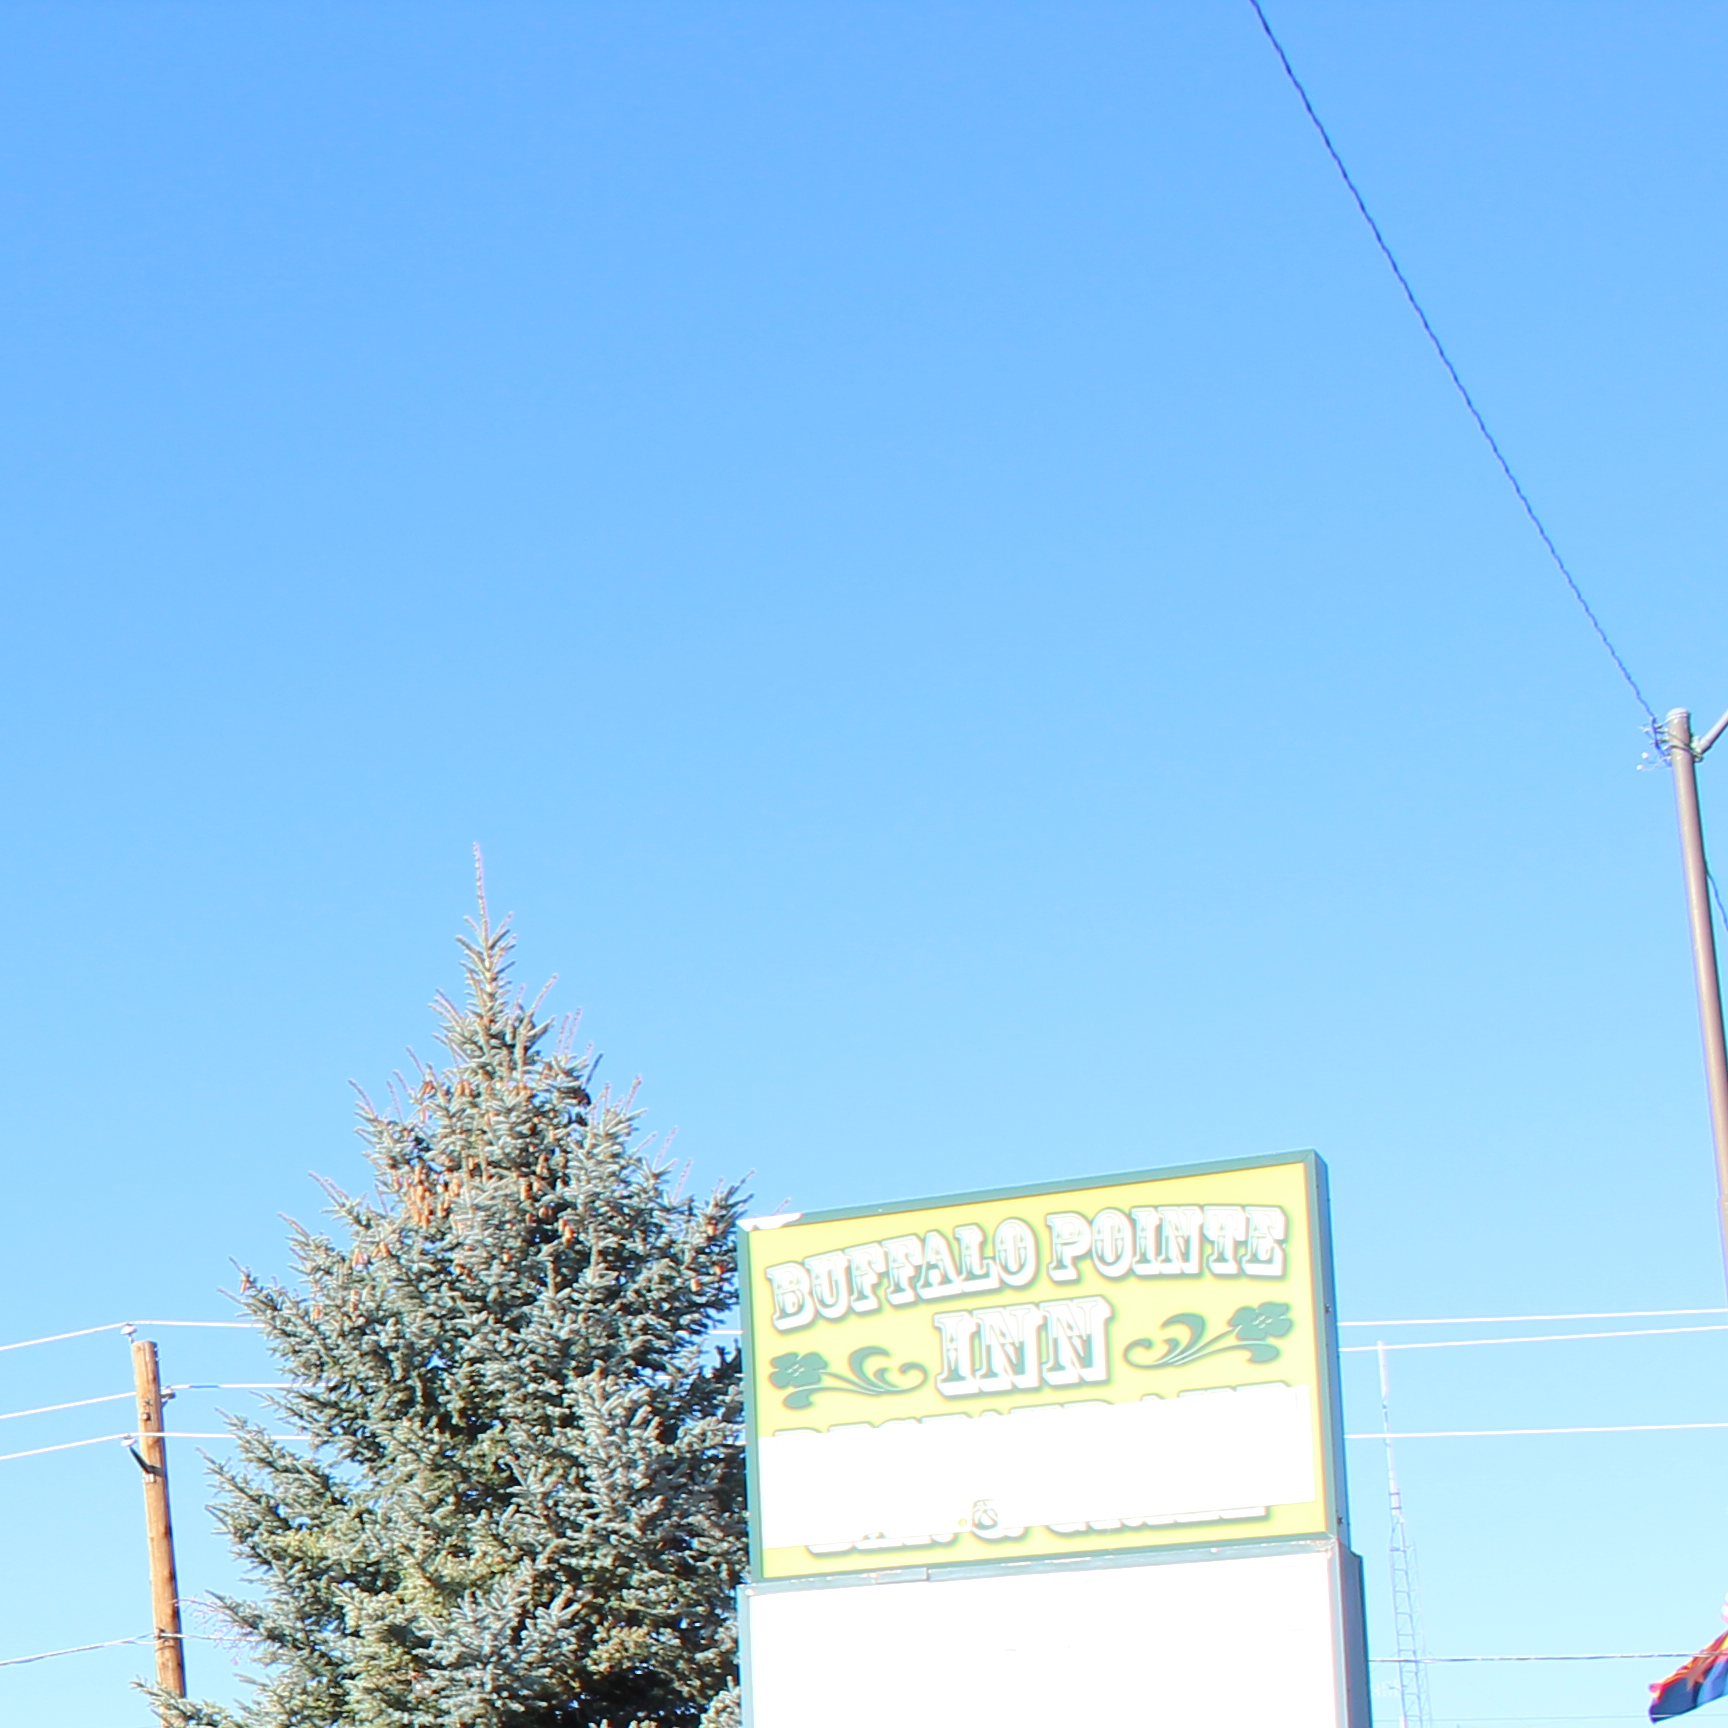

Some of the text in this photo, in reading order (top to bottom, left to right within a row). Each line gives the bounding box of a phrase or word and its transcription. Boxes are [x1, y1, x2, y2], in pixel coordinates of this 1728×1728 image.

[766, 1204, 1289, 1332] BUFFALO POINTE
[934, 1295, 1114, 1397] INN
